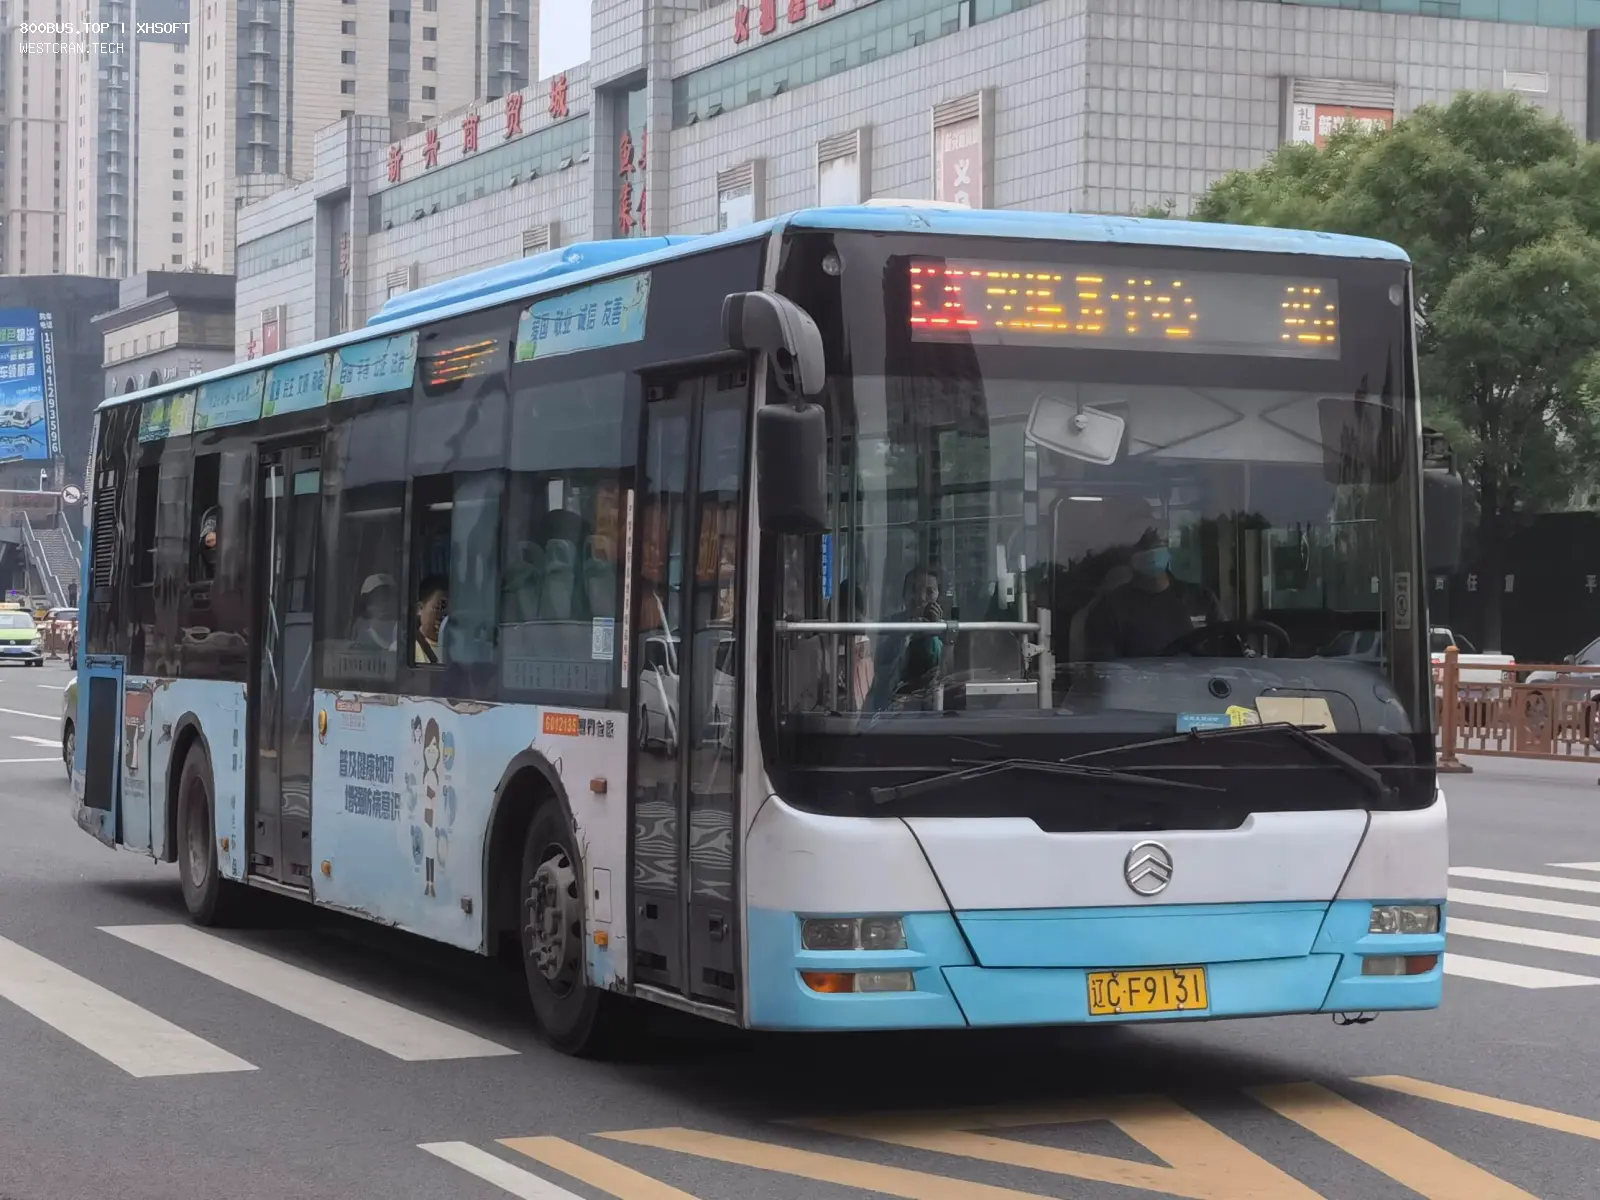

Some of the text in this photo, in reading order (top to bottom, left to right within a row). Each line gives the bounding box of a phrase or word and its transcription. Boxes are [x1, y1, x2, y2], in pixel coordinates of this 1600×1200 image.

[387, 72, 569, 184] 新兴商贸城
[44, 332, 58, 453] 15841293596
[339, 749, 395, 785] 普及健康知识
